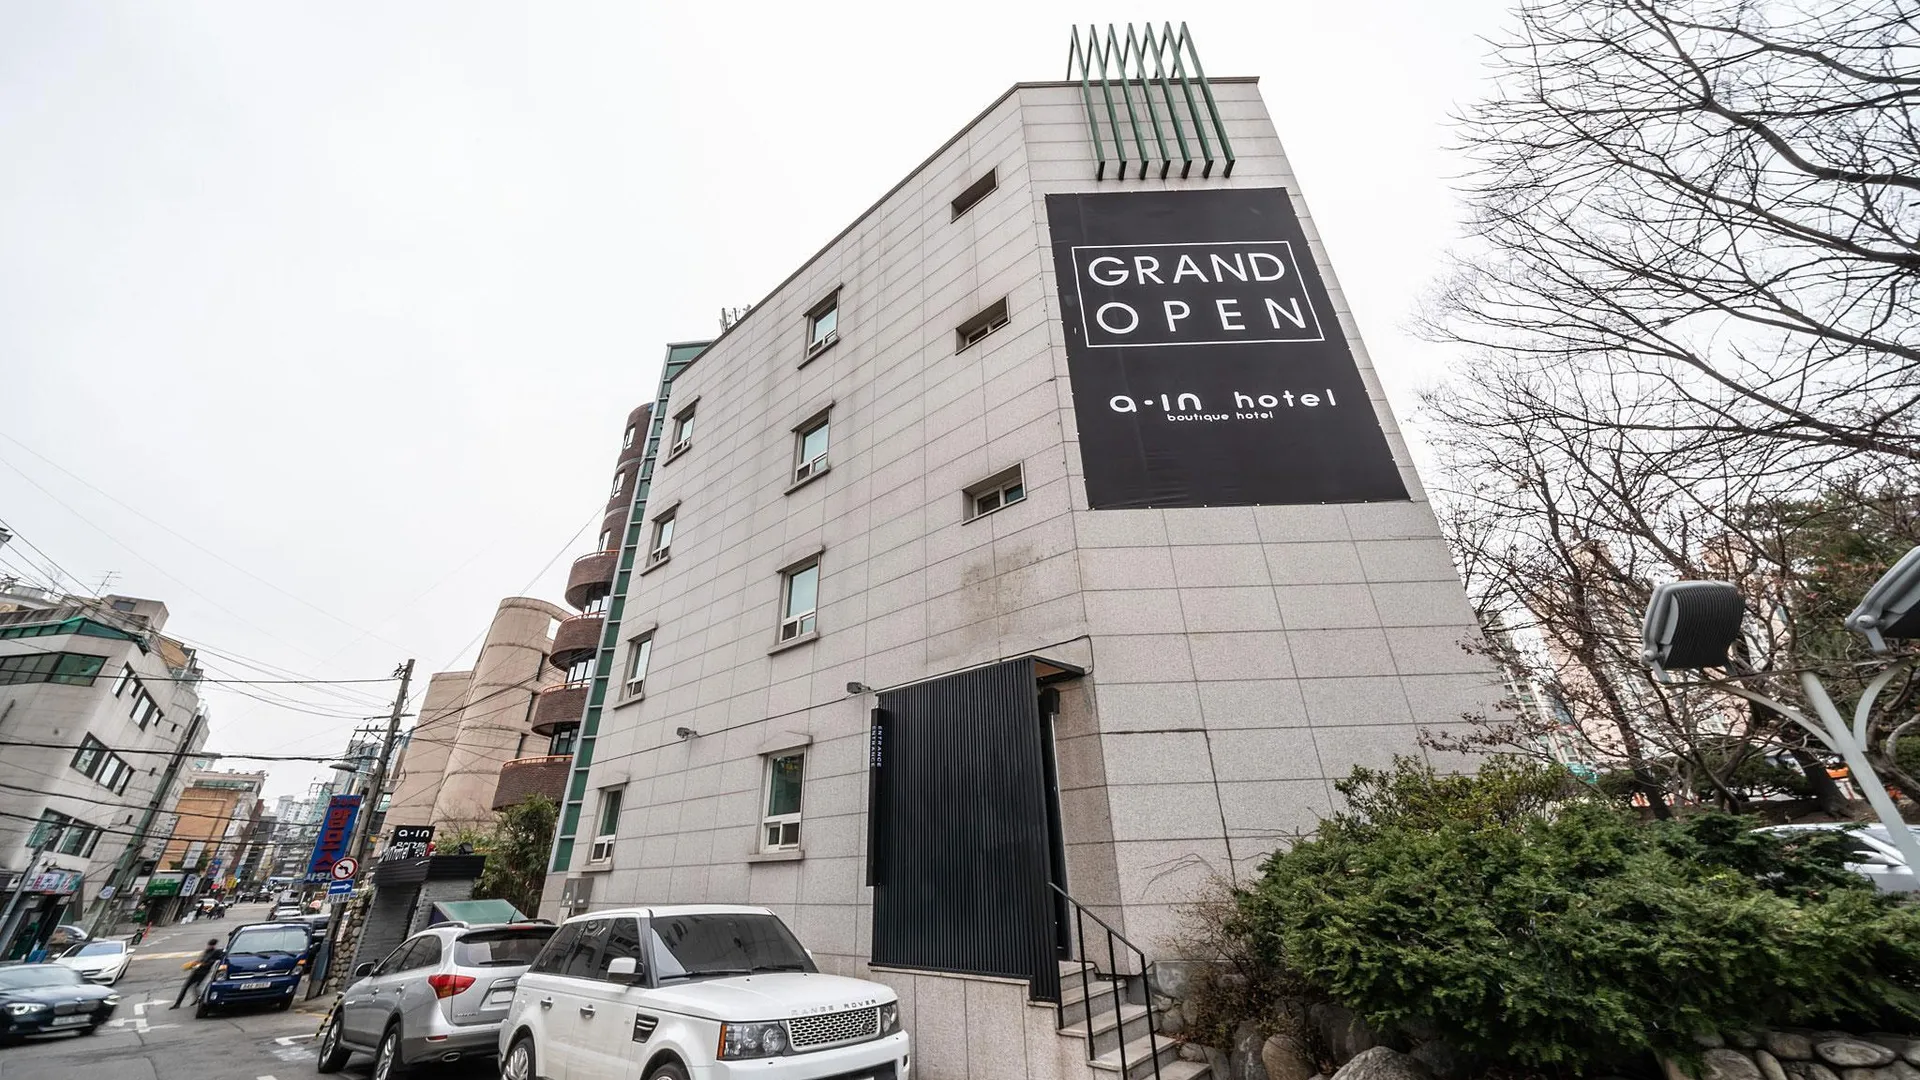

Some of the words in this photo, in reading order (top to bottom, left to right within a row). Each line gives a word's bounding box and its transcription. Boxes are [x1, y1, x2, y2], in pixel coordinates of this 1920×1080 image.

[1088, 252, 1286, 287] GRAND
[1096, 297, 1307, 335] OPEN
[1234, 389, 1337, 409] hotel
[1166, 413, 1230, 423] boutique
[1236, 411, 1274, 420] hotel
[843, 999, 877, 1009] ROVER
